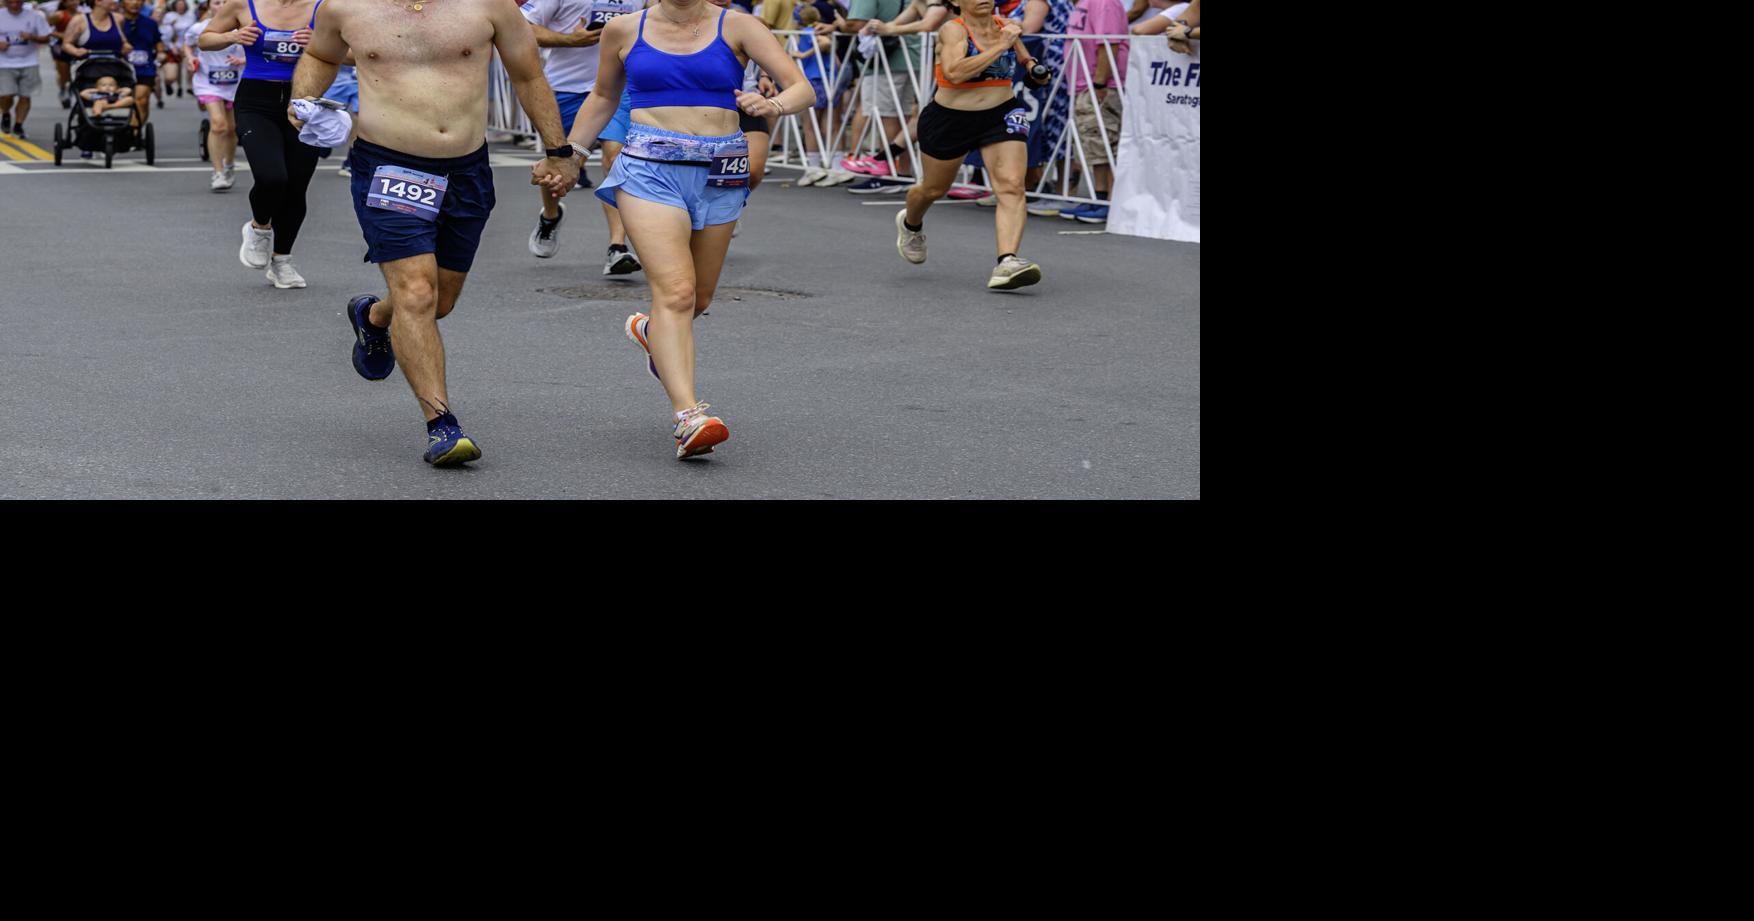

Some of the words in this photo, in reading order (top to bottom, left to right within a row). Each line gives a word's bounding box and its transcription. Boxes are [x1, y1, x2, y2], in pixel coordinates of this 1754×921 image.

[212, 71, 234, 79] 450
[1151, 60, 1182, 87] The
[1166, 92, 1200, 108] Saratog
[381, 179, 437, 206] 1492
